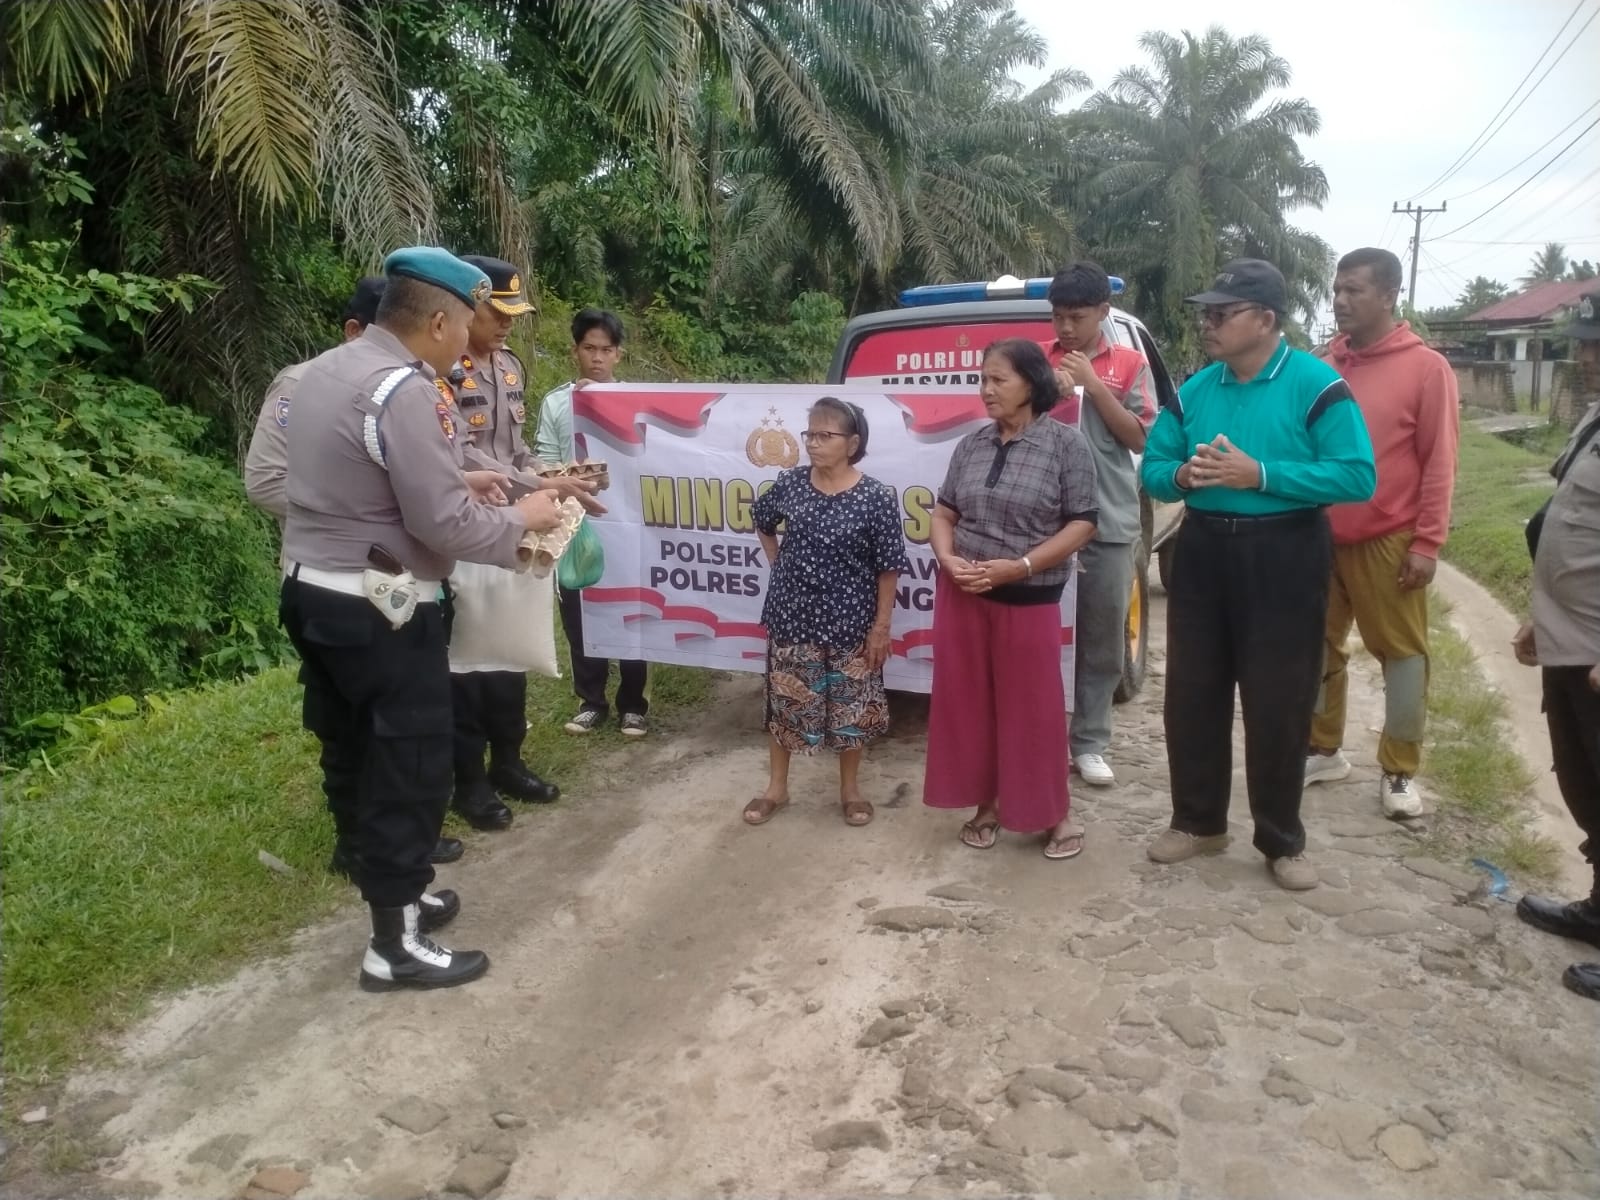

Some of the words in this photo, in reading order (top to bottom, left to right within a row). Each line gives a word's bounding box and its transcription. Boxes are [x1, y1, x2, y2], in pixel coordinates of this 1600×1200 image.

[896, 351, 955, 371] POLRI
[640, 475, 786, 534] MING
[660, 540, 763, 568] POLSEK
[650, 566, 761, 597] POLRES
